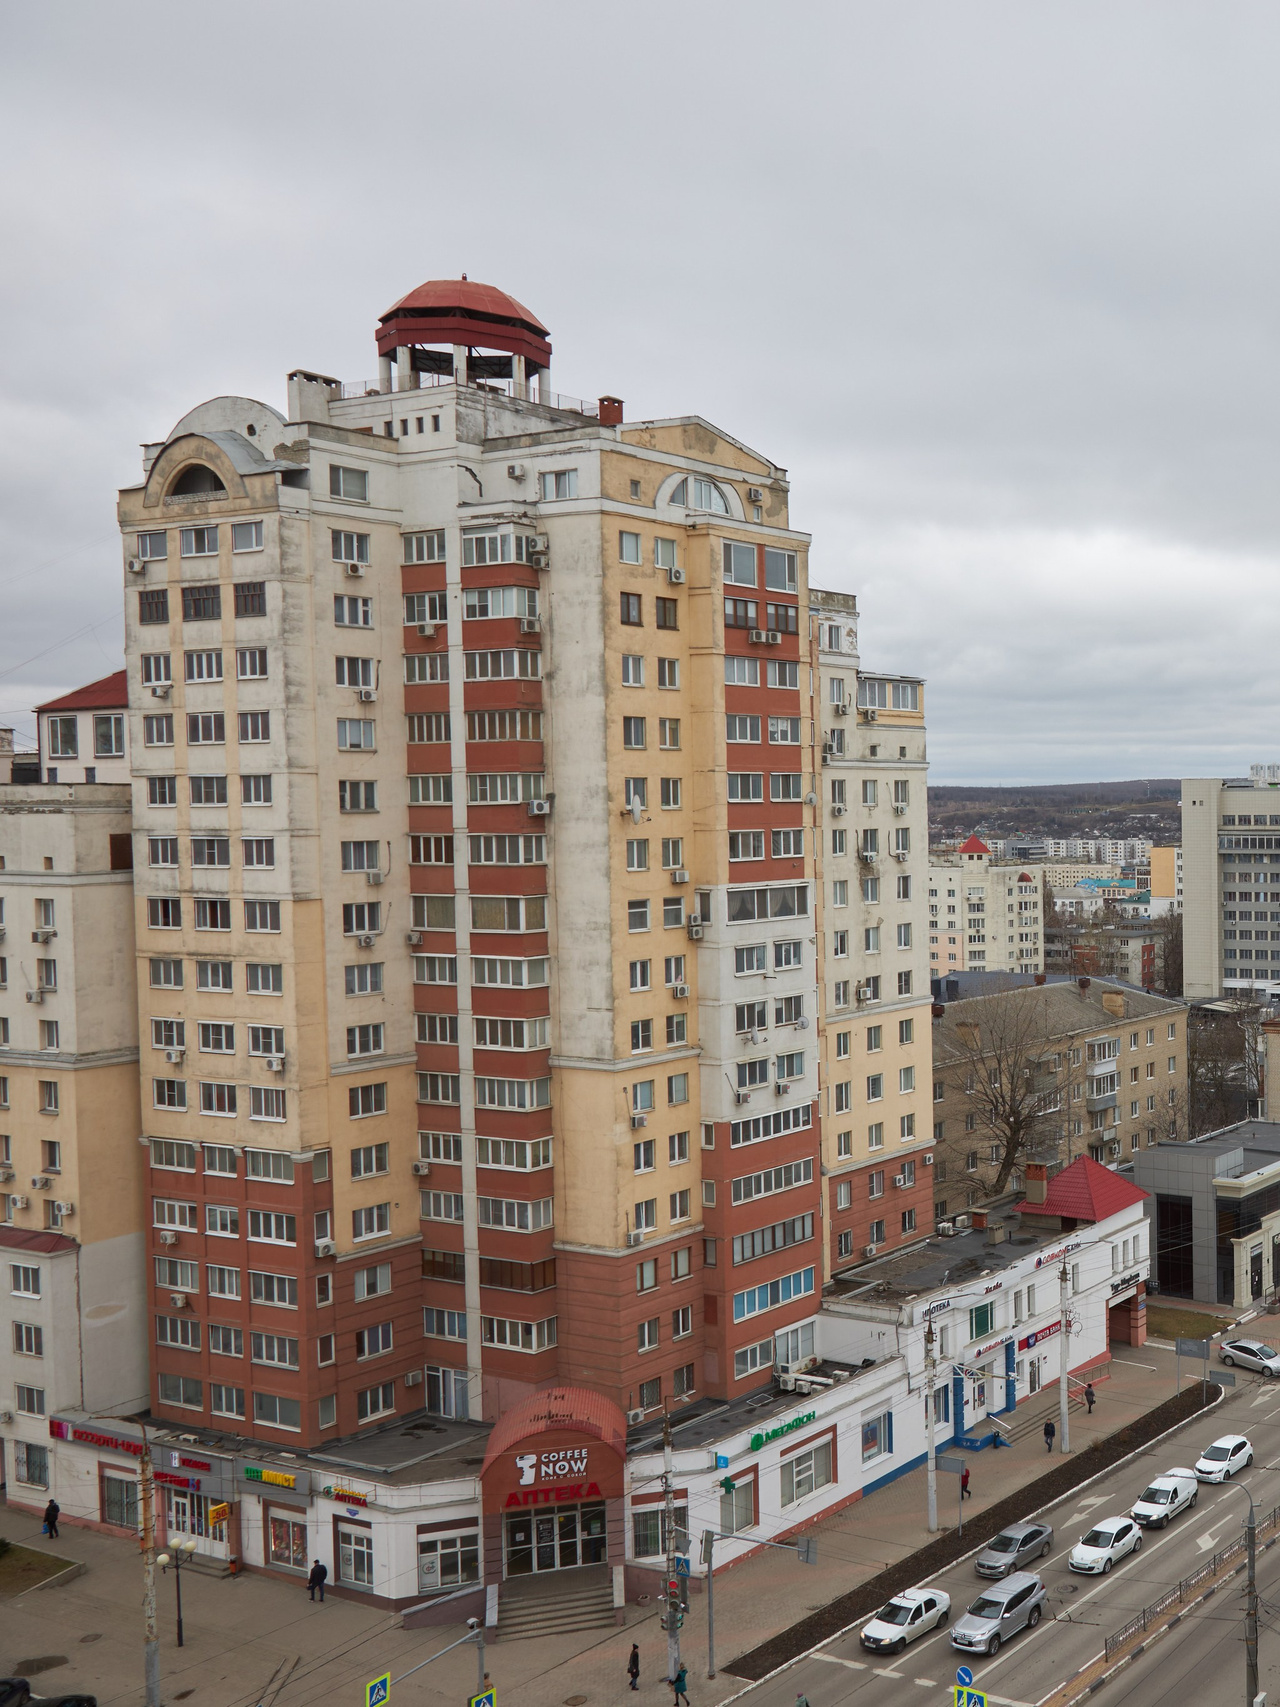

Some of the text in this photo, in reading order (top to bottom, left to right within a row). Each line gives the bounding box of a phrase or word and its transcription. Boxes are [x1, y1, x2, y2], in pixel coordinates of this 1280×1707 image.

[541, 1448, 588, 1463] COFFEE
[541, 1458, 588, 1477] NOW
[334, 1492, 368, 1508] АПТЕКА
[505, 1482, 601, 1508] АПТЕКА
